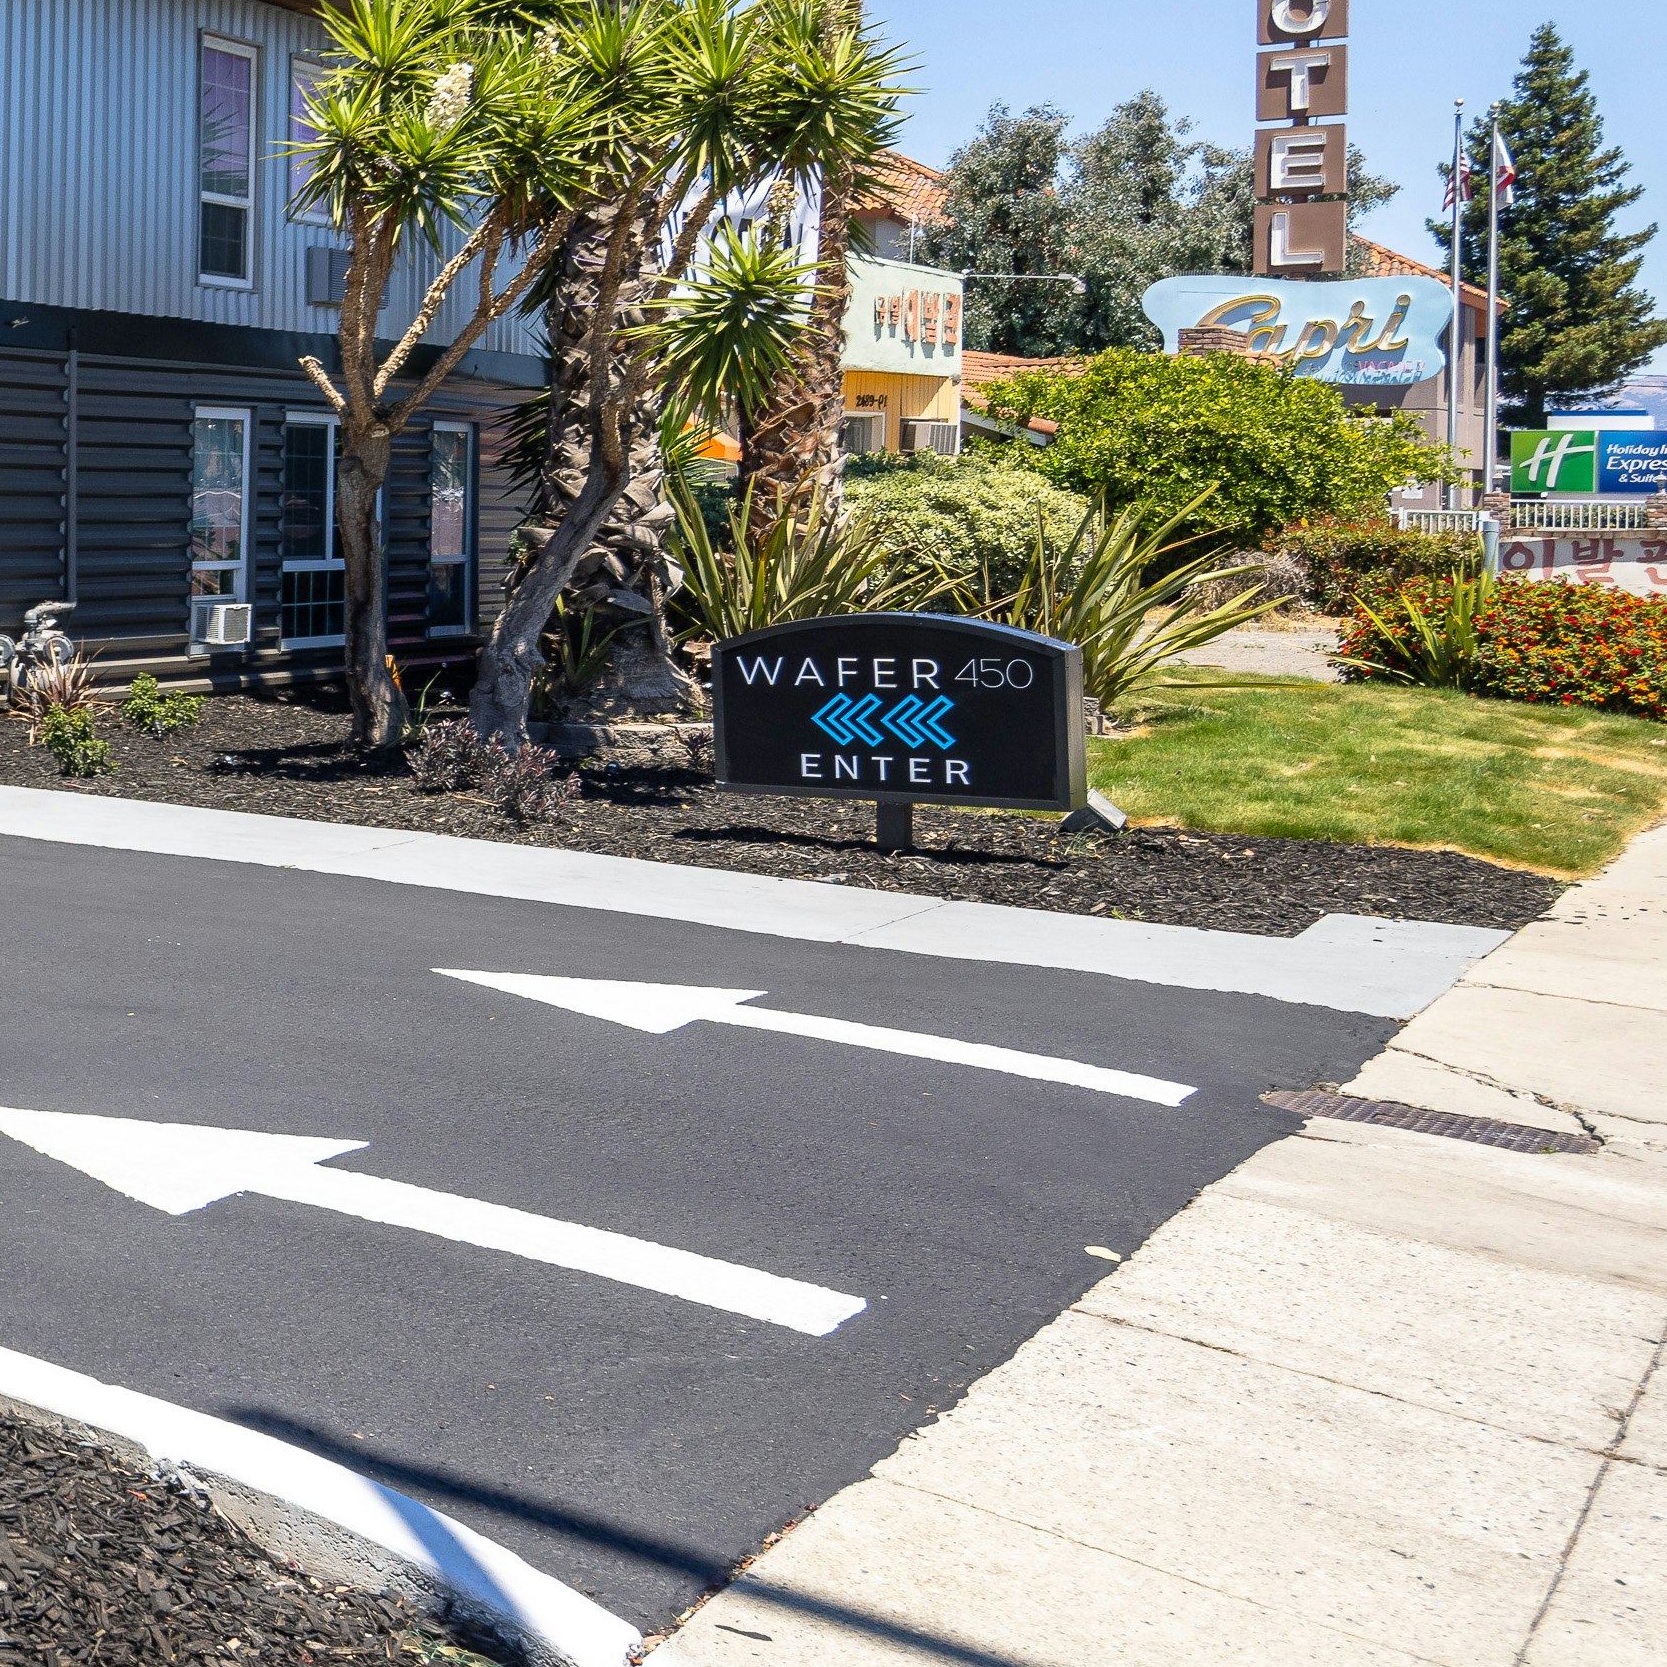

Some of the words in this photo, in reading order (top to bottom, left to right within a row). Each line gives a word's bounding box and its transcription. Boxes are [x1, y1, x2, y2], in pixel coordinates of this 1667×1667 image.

[1195, 294, 1410, 364] Capri
[1606, 443, 1659, 457] Holiday
[1618, 473, 1628, 483] &
[1630, 473, 1660, 483] Suite
[736, 655, 940, 689] WAFER
[954, 657, 1033, 689] 450
[800, 753, 970, 785] ENTER
